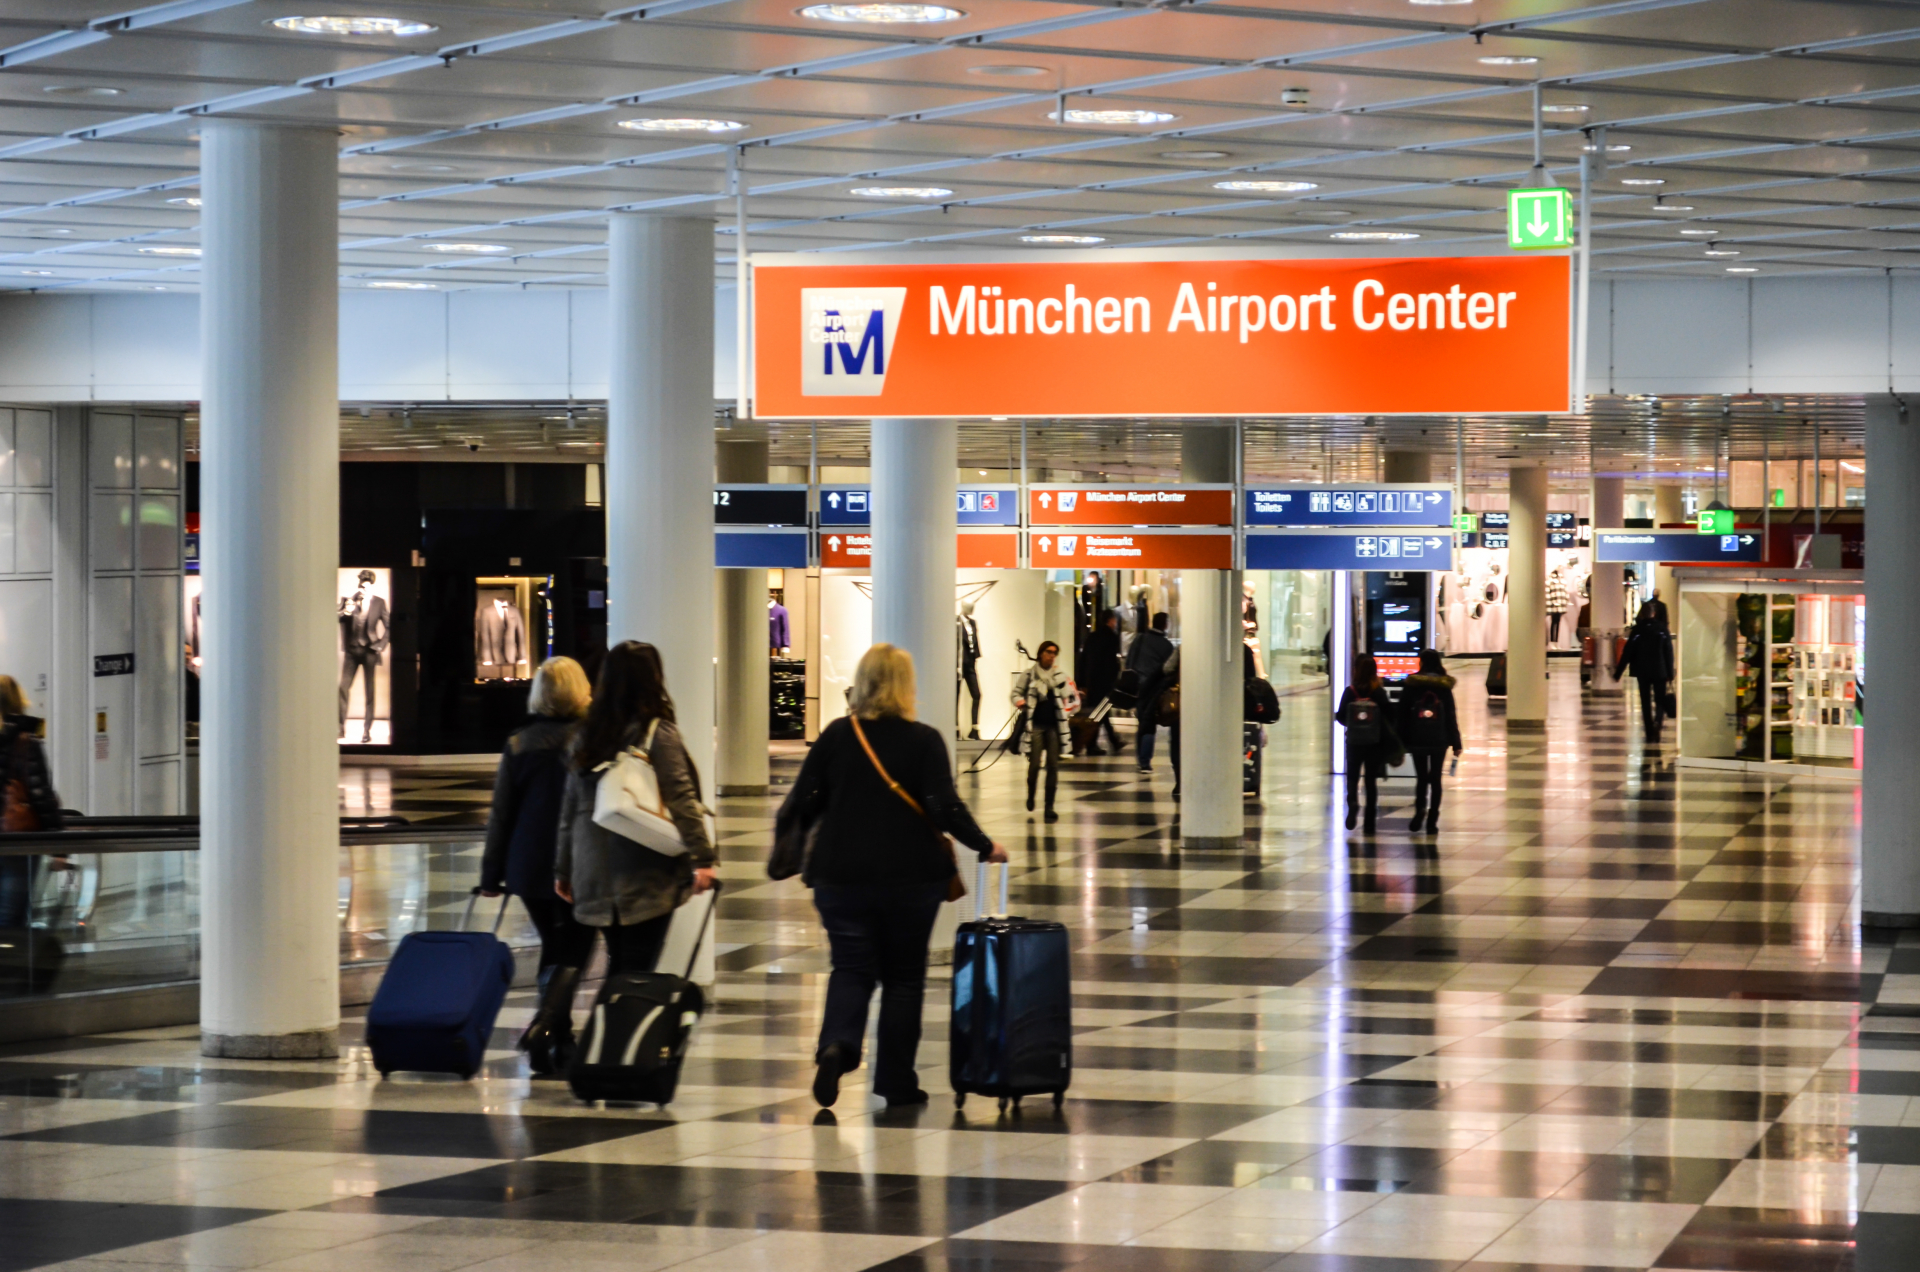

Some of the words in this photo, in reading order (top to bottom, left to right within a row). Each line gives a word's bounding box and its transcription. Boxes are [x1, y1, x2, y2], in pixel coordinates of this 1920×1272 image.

[808, 295, 884, 310] München
[929, 284, 1151, 336] München
[1167, 281, 1337, 344] Airport
[1352, 278, 1518, 333] Center
[808, 311, 866, 331] Airport
[808, 327, 861, 343] Center
[848, 495, 866, 504] BUS
[1085, 492, 1126, 502] München
[1127, 492, 1157, 504] Airport
[1157, 492, 1186, 502] Center
[1253, 491, 1292, 502] Toiletten
[1253, 502, 1283, 513] Toilets
[1722, 537, 1732, 549] P
[94, 658, 123, 674] Change
